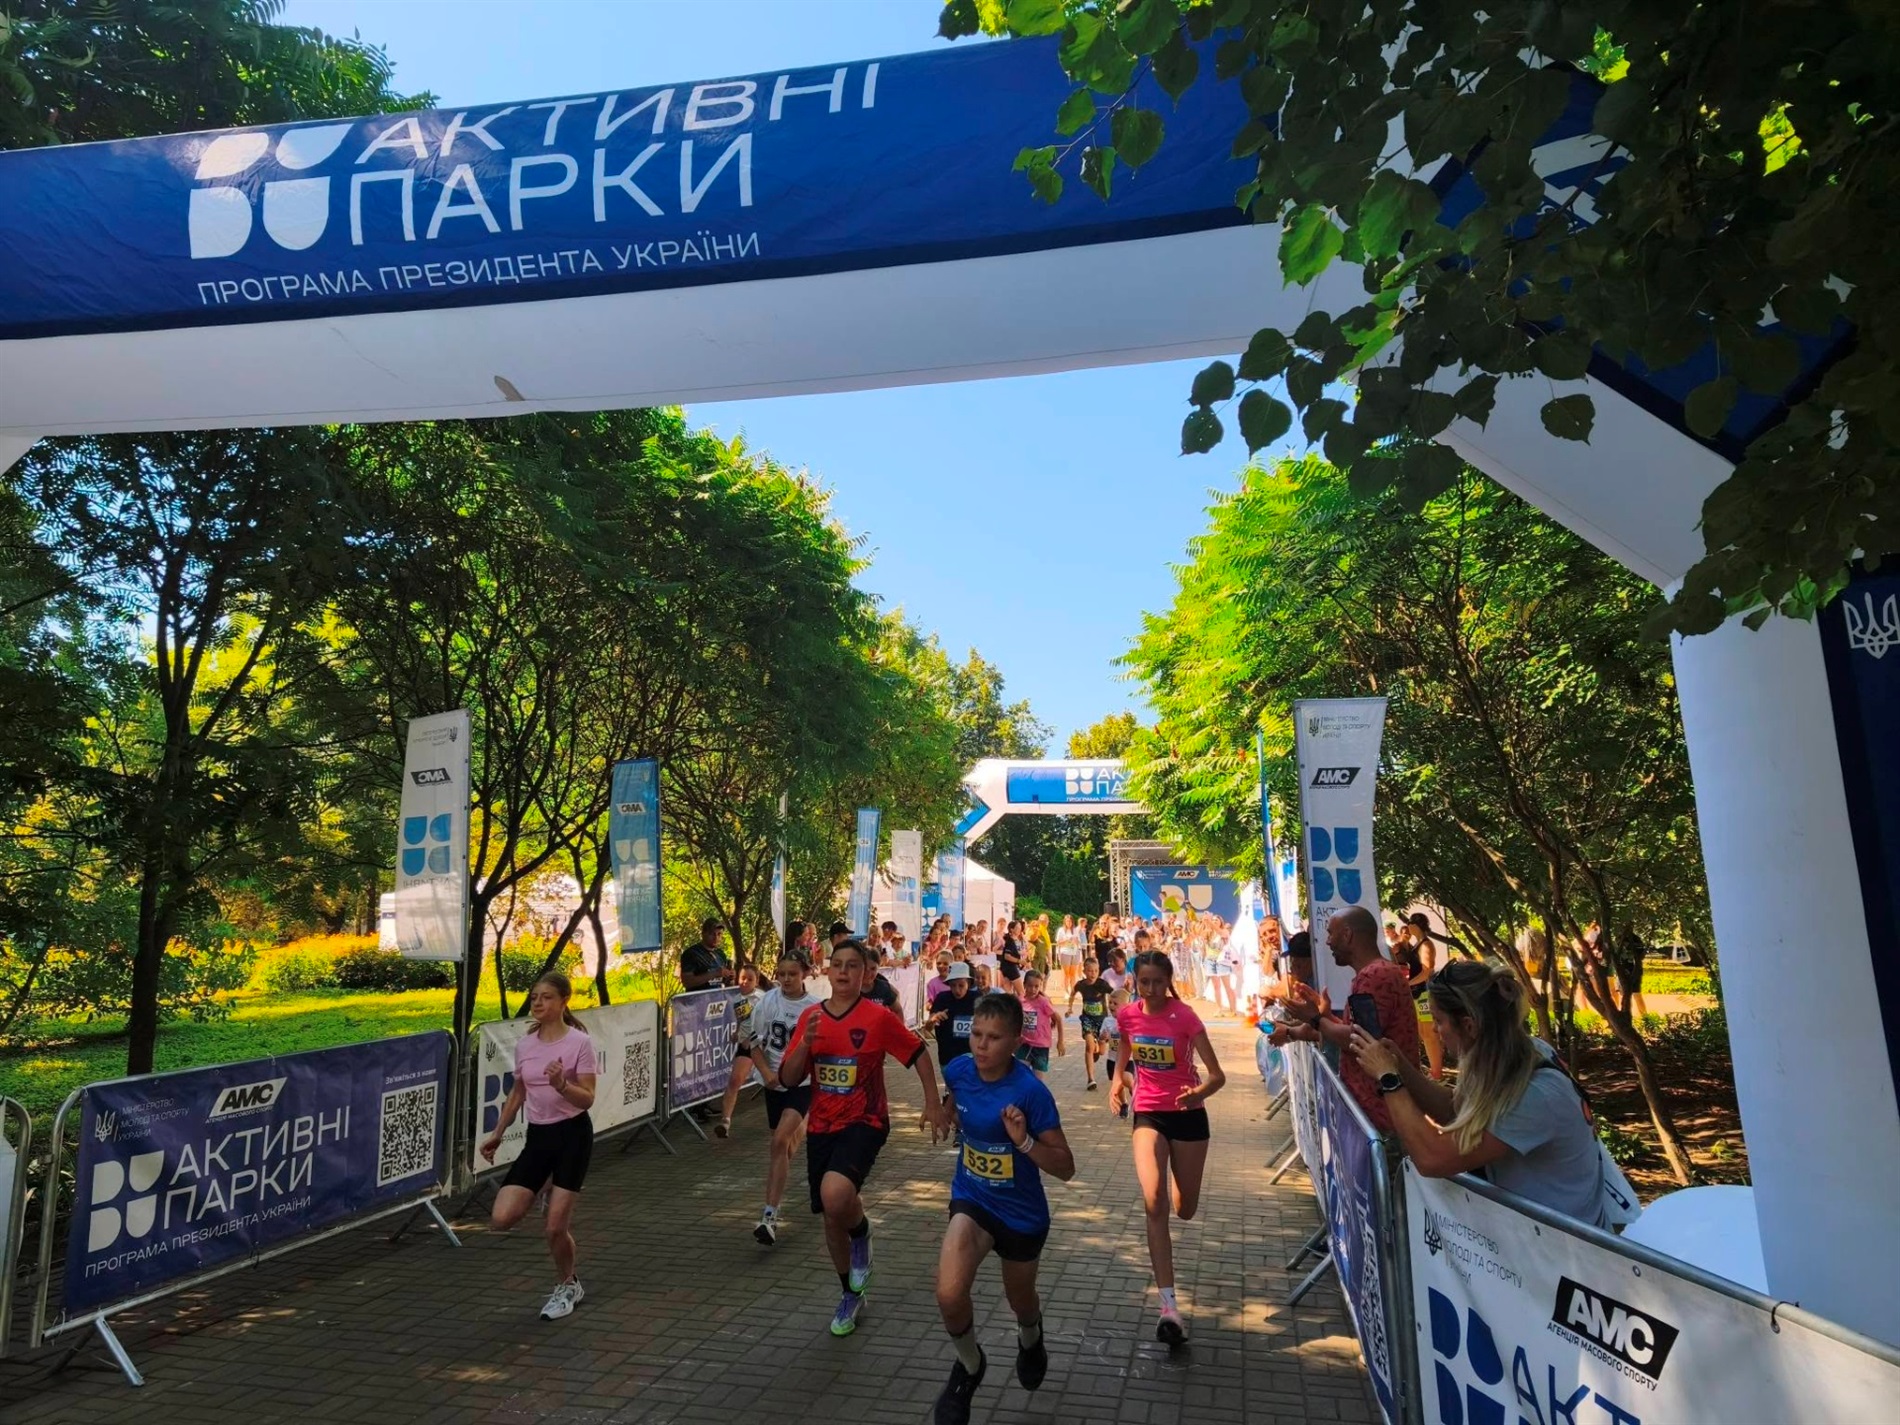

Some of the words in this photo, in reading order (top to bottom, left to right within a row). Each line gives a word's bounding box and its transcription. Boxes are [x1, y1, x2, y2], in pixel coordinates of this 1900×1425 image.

[354, 62, 881, 165] АКТИВНІ
[349, 132, 754, 246] ПАРКИ
[197, 269, 373, 305] ПРОГРАМА
[378, 248, 604, 295] ПРЕЗИДЕНТА
[611, 230, 761, 269] УКРАЇНИ
[1317, 769, 1351, 784] АМС
[695, 1021, 738, 1050] АКТИВ
[695, 1041, 739, 1072] ПАРКИ
[1137, 1046, 1166, 1061] 531
[219, 1083, 274, 1112] АМС
[819, 1066, 849, 1083] 536
[169, 1105, 350, 1186] АКТИВНІ
[967, 1148, 1004, 1176] 532
[163, 1151, 314, 1230] ПАРКИ
[85, 1240, 169, 1279] ПРОГРАМА
[172, 1212, 260, 1250] ПРЕЗИДЕНТА
[262, 1195, 311, 1221] УКРАЇНИ
[1439, 1214, 1500, 1255] МІНІСТЕРСТВО
[1444, 1239, 1473, 1264] ОЛОДІ
[1473, 1252, 1485, 1270] ТА
[1485, 1260, 1523, 1289] СПОРТУ
[1566, 1287, 1656, 1366] АМС
[1546, 1322, 1580, 1347] АГЕНЦІЯ
[1580, 1340, 1623, 1372] МАСОВОГО
[1623, 1365, 1659, 1392] СПОРТУ
